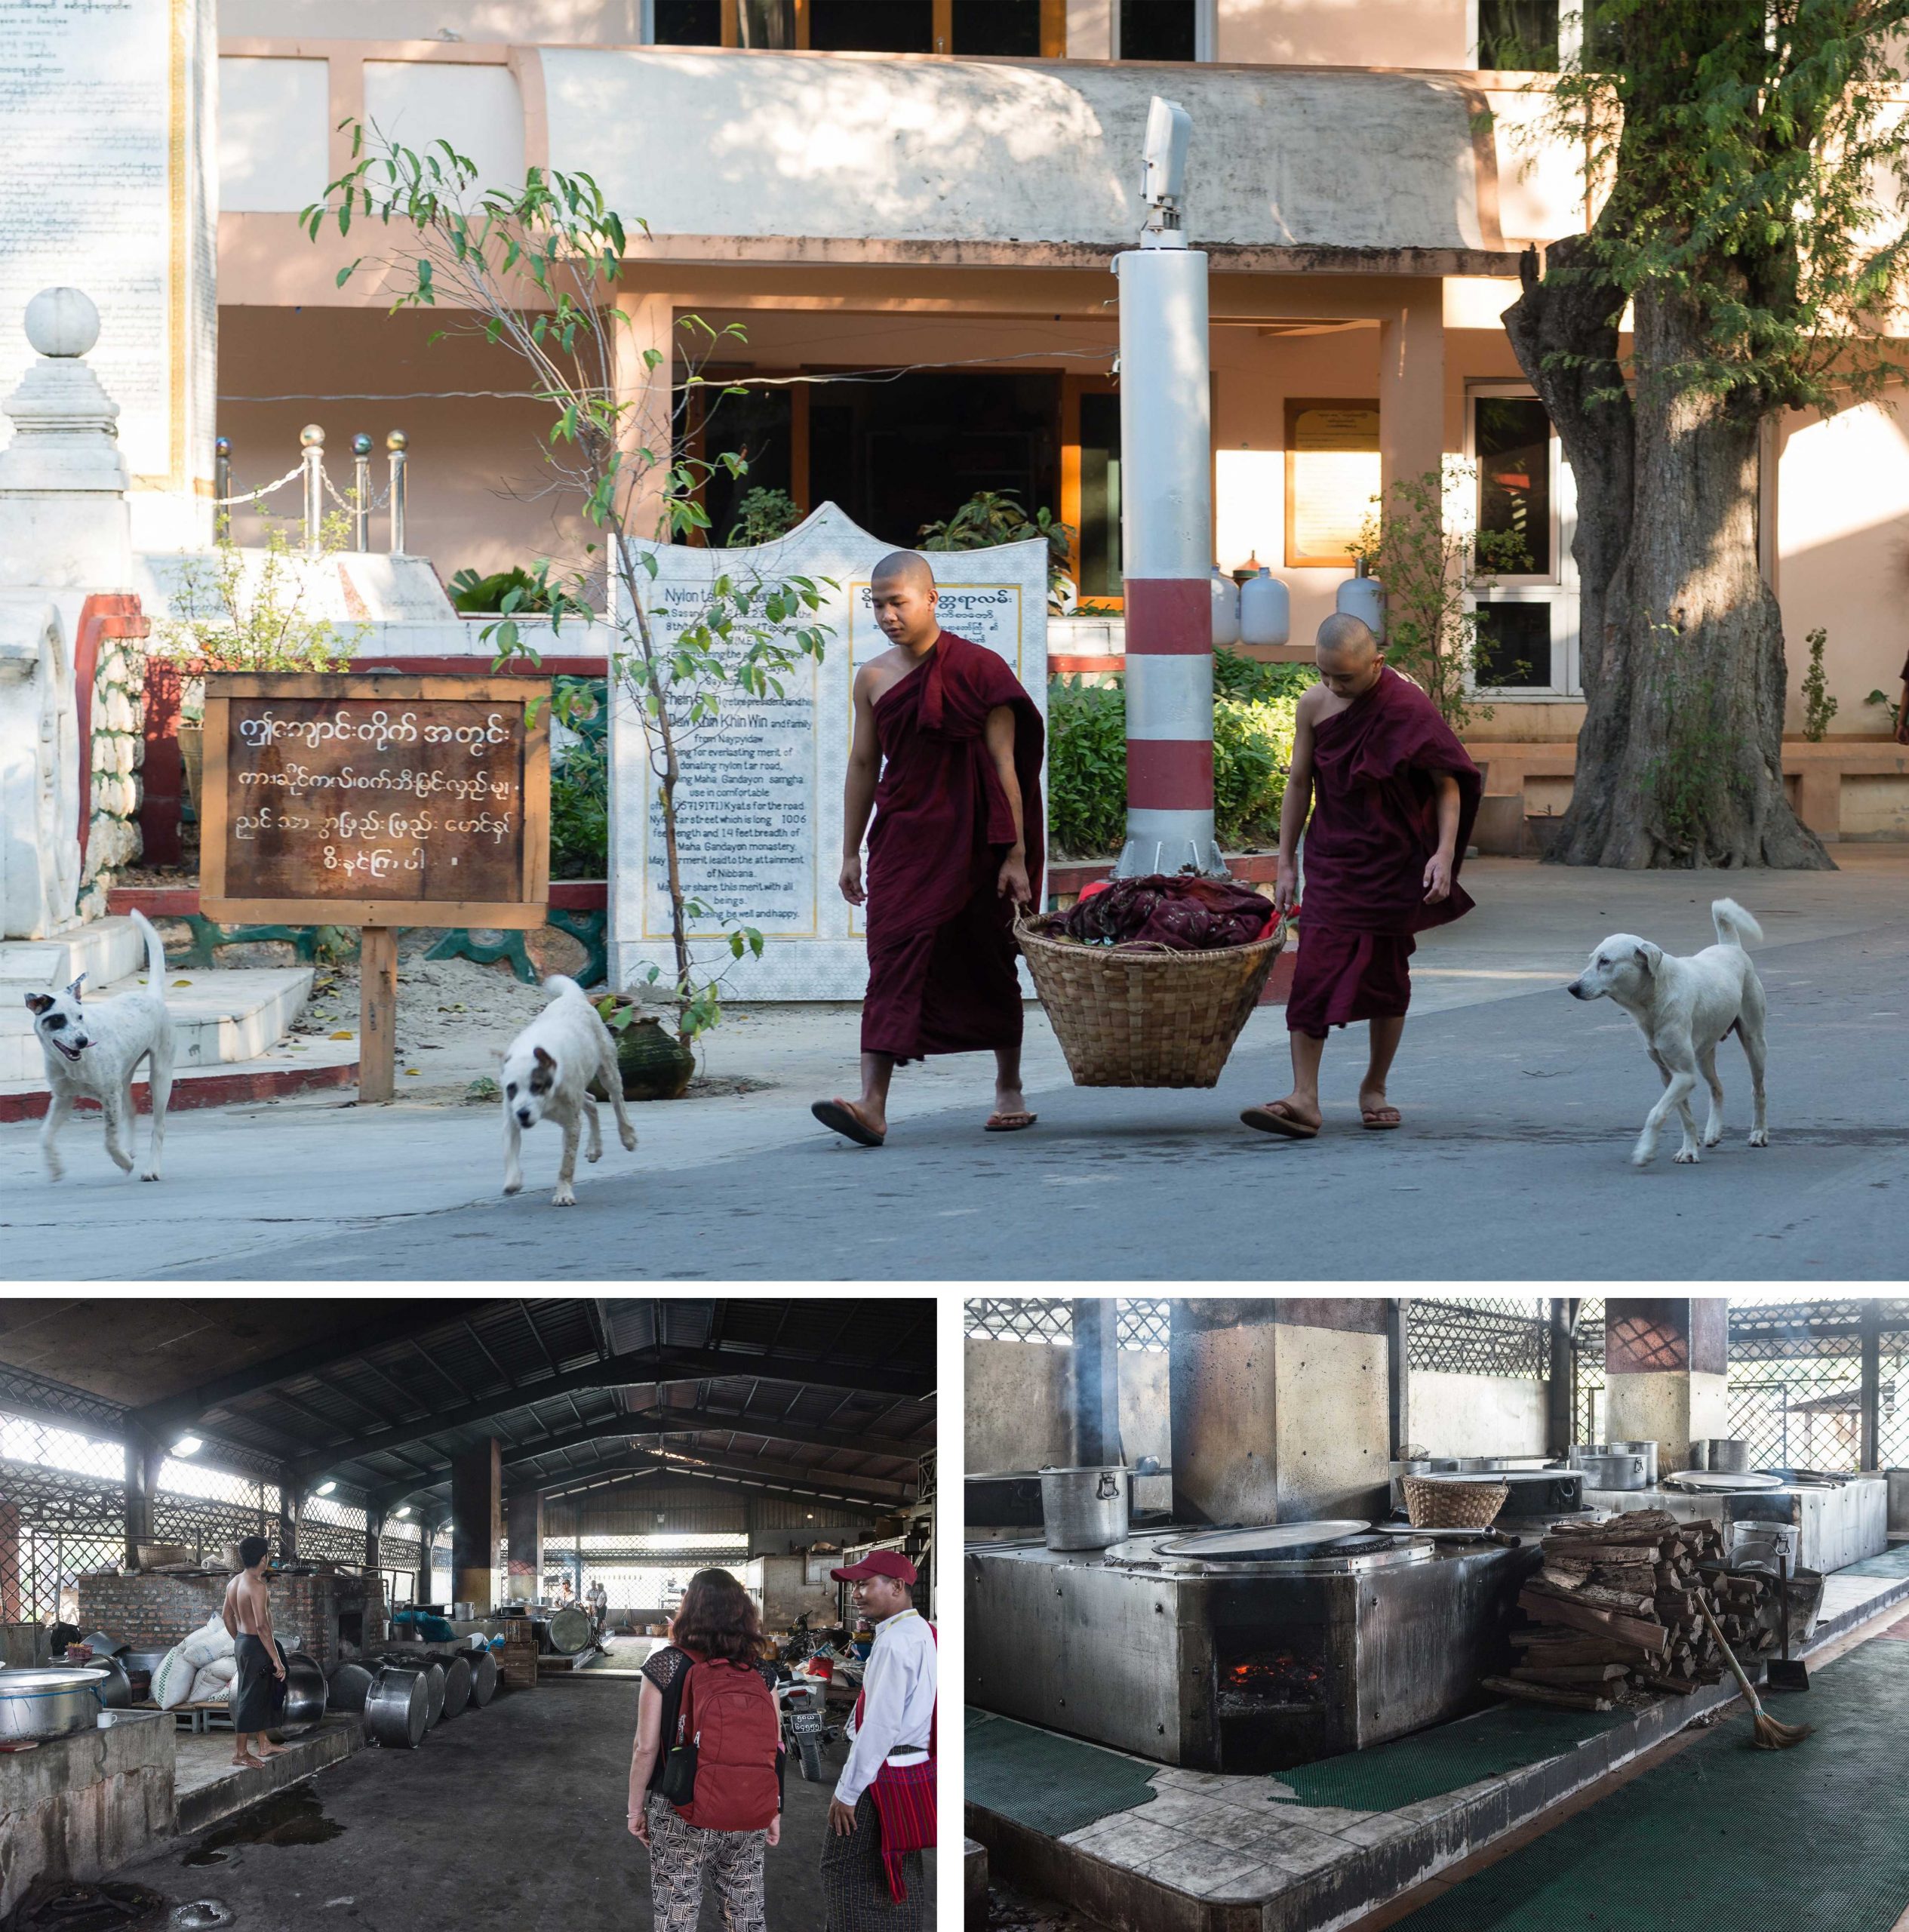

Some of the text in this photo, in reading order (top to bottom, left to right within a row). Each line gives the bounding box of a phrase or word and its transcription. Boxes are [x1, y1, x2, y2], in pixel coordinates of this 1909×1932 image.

[665, 589, 699, 605] Nylon
[701, 589, 718, 602] ta
[693, 714, 719, 728] hin
[721, 713, 746, 728] Khin
[747, 713, 768, 728] Win
[694, 734, 764, 746] from Naypyidaw
[708, 747, 756, 758] everlasting
[782, 747, 794, 757] of
[680, 761, 717, 773] donating
[718, 761, 743, 773] nylon
[744, 761, 758, 771] tar
[694, 774, 717, 784] Maha
[721, 774, 764, 786] Gandayon
[706, 788, 715, 797] in
[716, 787, 770, 797] comfortable
[767, 801, 782, 811] the
[782, 801, 804, 811] road
[690, 814, 720, 824] street
[752, 814, 772, 826] long
[782, 814, 807, 824] 1006
[675, 829, 702, 840] ength
[702, 829, 719, 838] and
[790, 829, 801, 838] of
[678, 842, 701, 851] Maha
[704, 841, 747, 854] Gandayon
[738, 856, 754, 865] the
[755, 855, 804, 865] attainment
[706, 868, 717, 878] of
[657, 882, 670, 892] Ma
[693, 882, 718, 892] share
[720, 882, 738, 892] this
[725, 909, 736, 918] be
